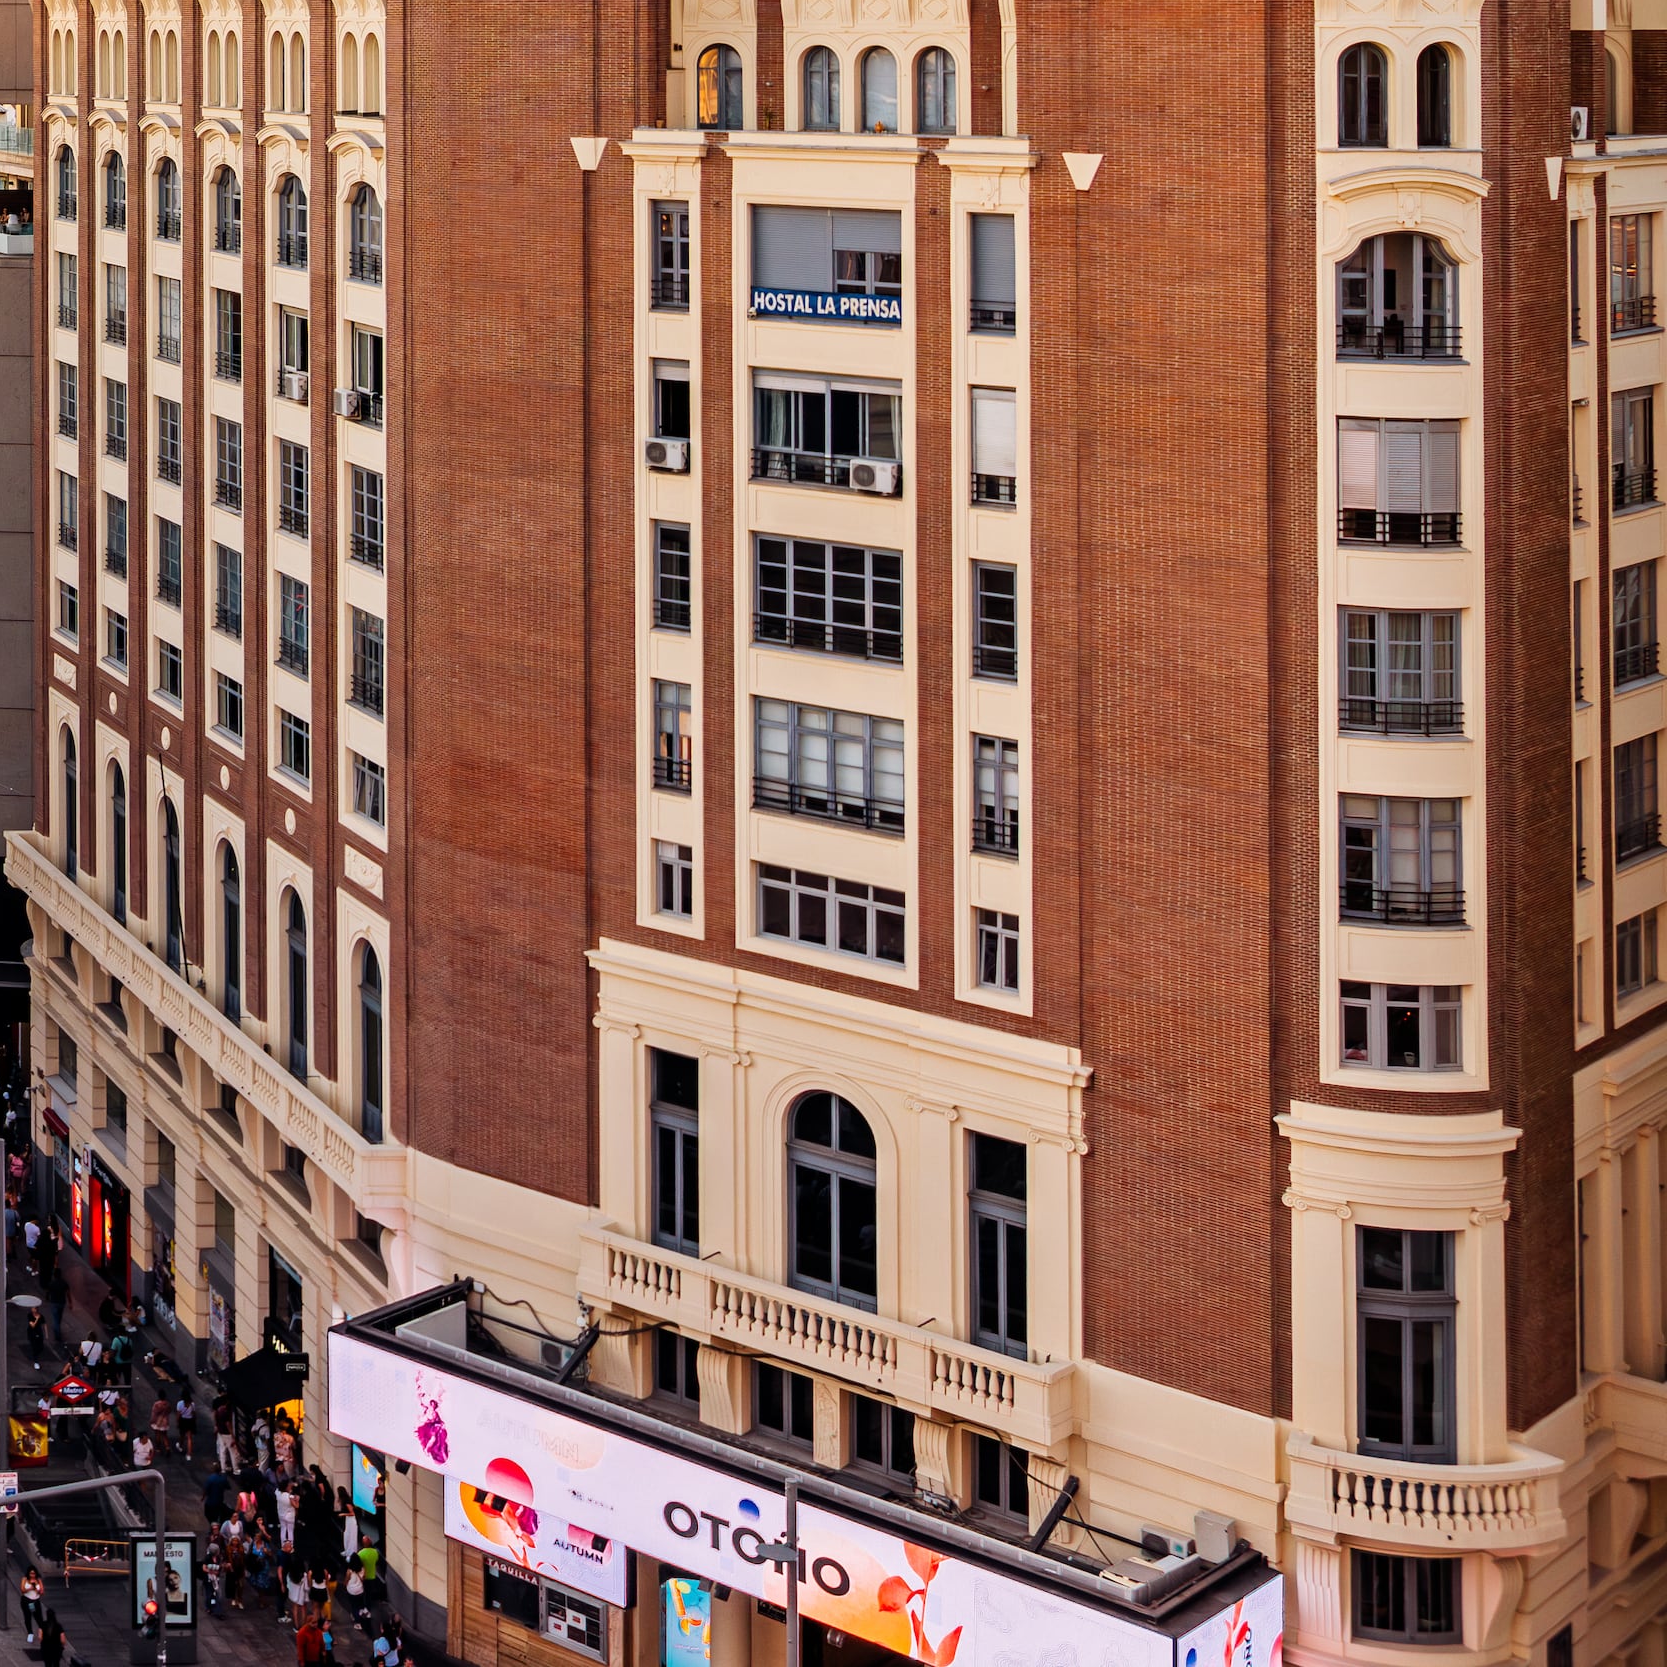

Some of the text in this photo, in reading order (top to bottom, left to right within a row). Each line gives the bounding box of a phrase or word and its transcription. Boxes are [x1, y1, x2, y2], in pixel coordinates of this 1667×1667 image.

[754, 291, 901, 319] HOSTAL LA PRENSA
[553, 1538, 603, 1564] AUTUMN
[487, 1558, 539, 1586] TAQUILLA
